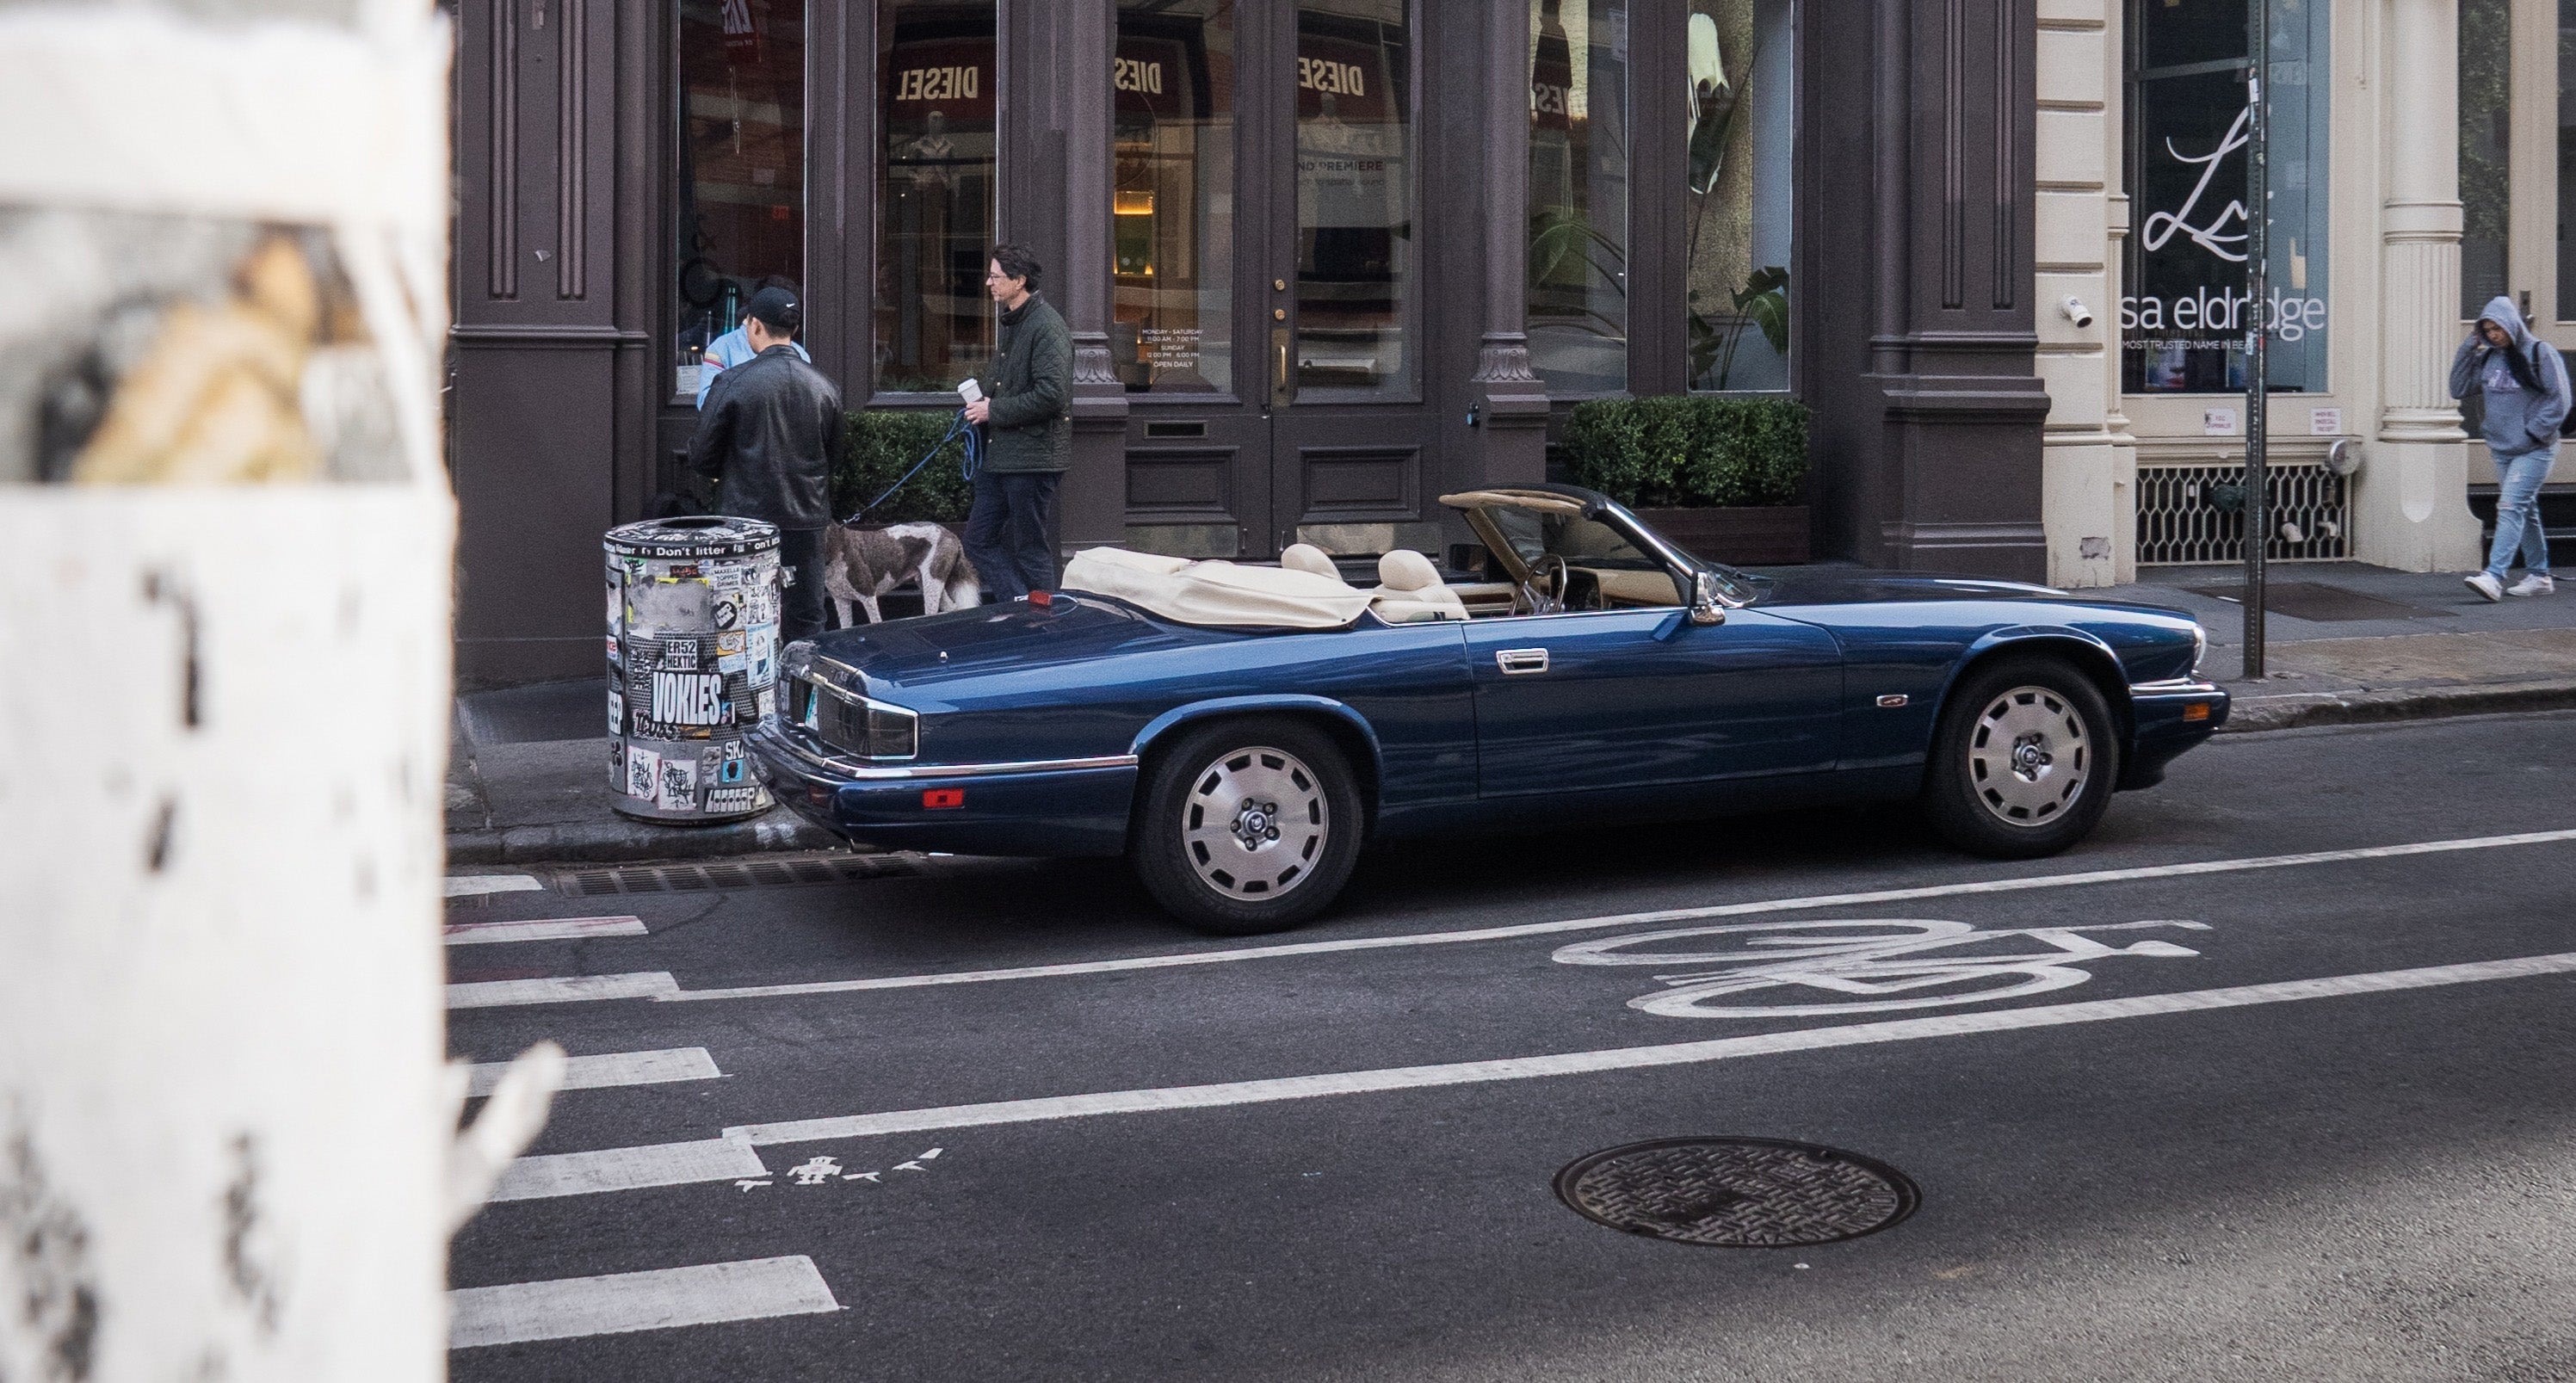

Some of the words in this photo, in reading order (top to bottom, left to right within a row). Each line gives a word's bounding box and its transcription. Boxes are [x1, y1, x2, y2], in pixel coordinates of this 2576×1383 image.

[1319, 161, 1384, 171] PREMIERE
[2173, 286, 2325, 342] eldrdge
[2122, 340, 2147, 349] MOST
[2150, 340, 2191, 349] TRUSTED
[2193, 340, 2220, 349] NAME
[2221, 340, 2231, 349] IN
[656, 546, 690, 556] Don't
[695, 546, 726, 556] litter
[667, 641, 696, 654] ER52
[667, 655, 696, 669] HEKTIC
[652, 671, 722, 725] VOKLES
